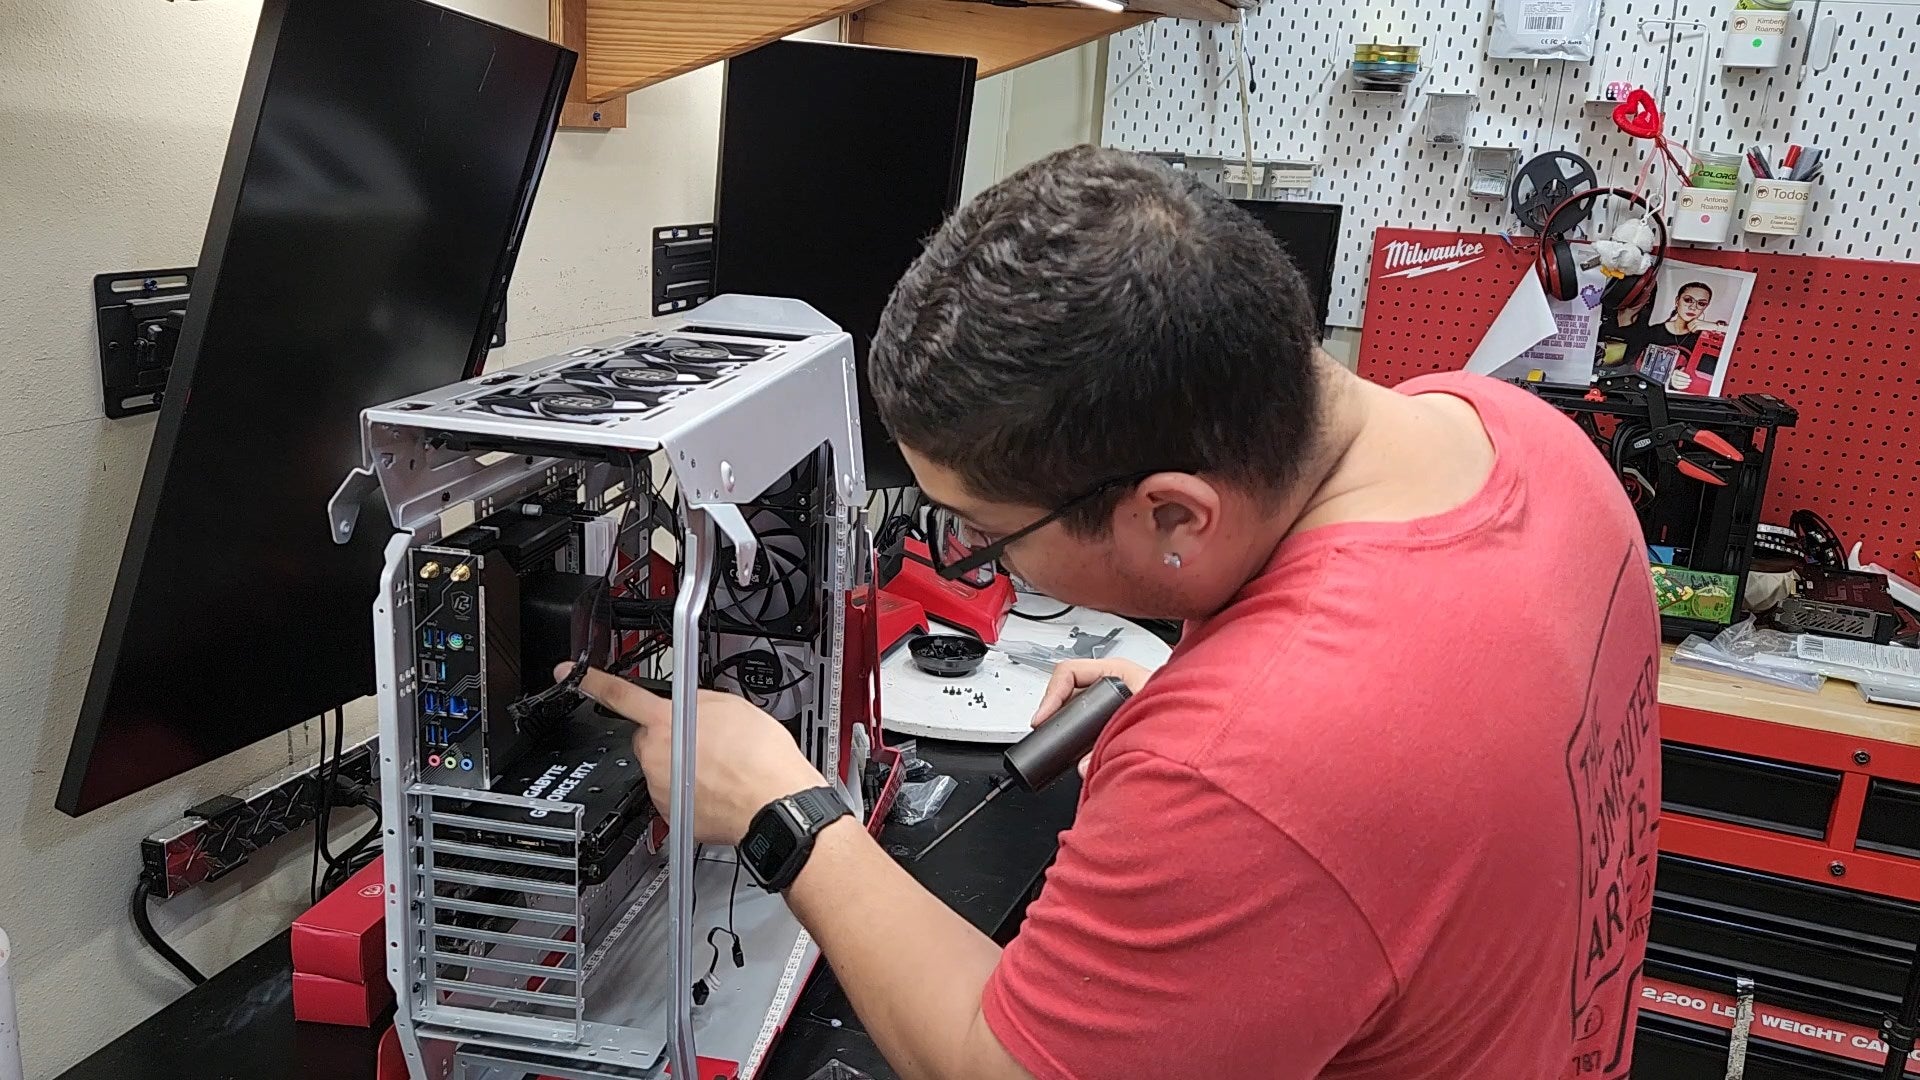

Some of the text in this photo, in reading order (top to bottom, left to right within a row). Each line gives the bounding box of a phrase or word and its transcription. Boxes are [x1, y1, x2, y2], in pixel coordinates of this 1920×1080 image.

[1755, 26, 1784, 34] Roaming
[1772, 187, 1809, 201] Todos
[1700, 203, 1729, 212] Roaming
[1380, 238, 1485, 270] Milwaukee
[569, 761, 598, 780] RTX
[1641, 986, 1707, 1011] 2,200
[1761, 1013, 1848, 1044] WEIGHT
